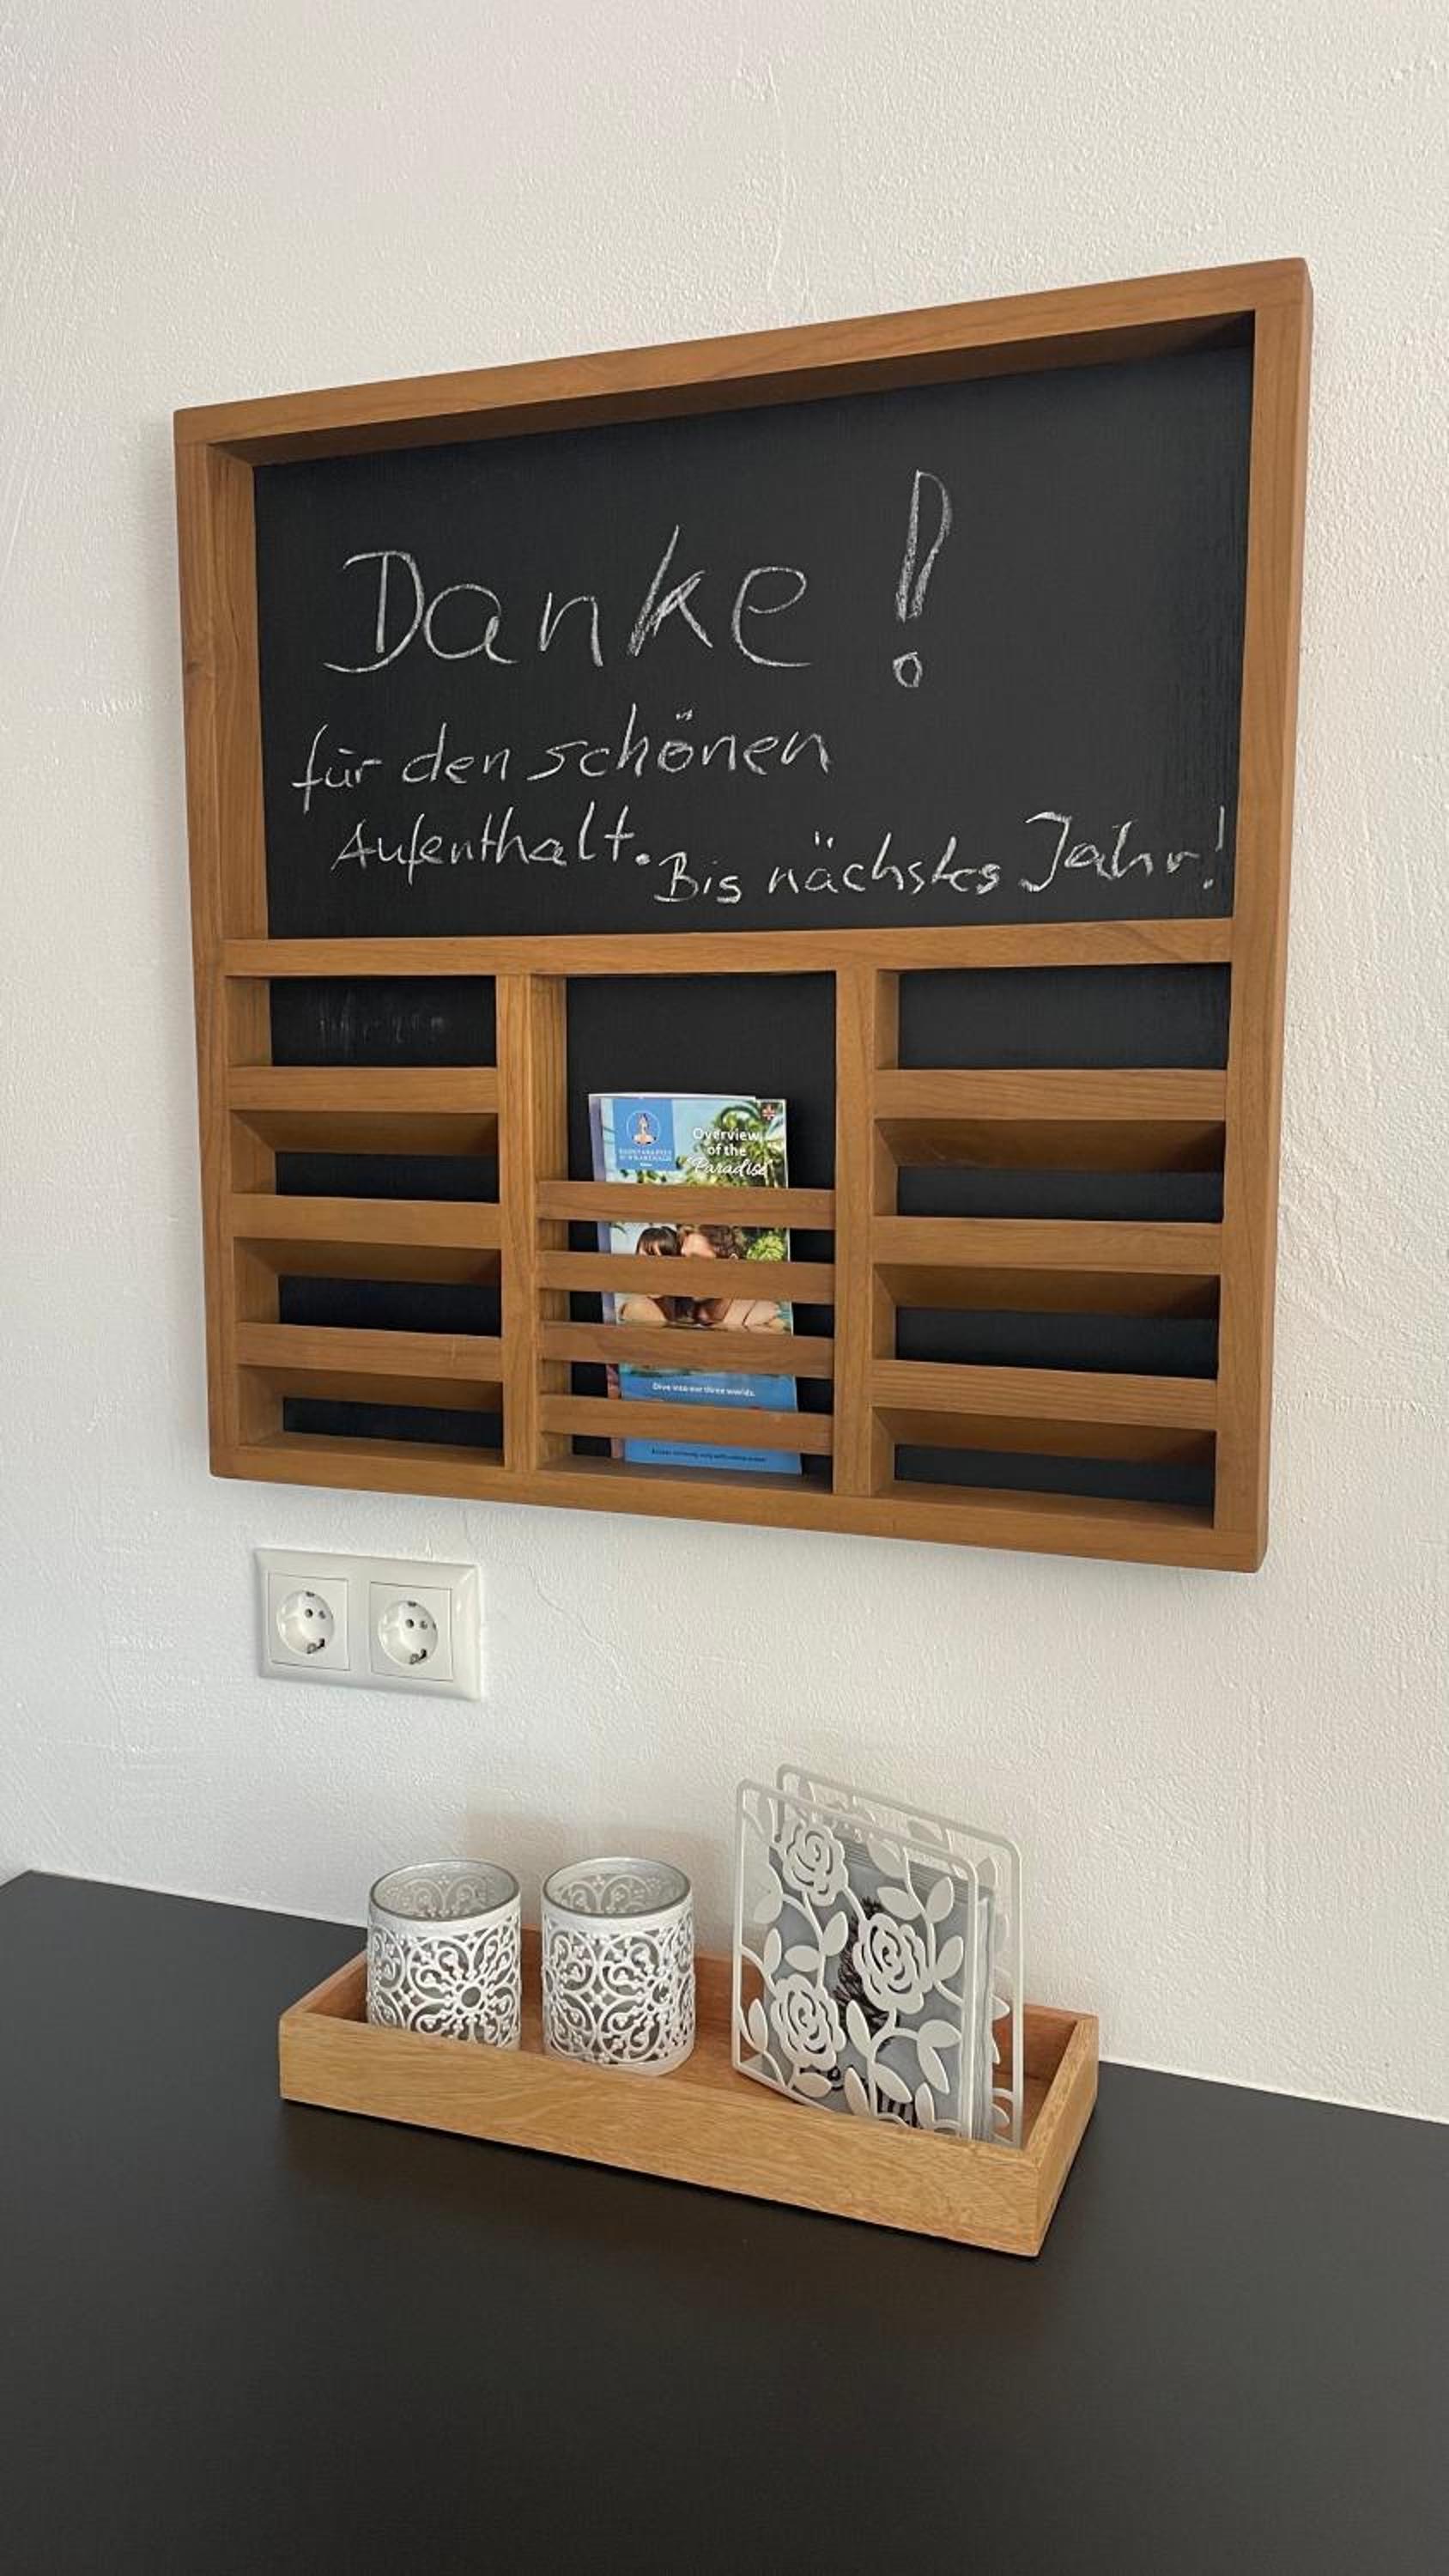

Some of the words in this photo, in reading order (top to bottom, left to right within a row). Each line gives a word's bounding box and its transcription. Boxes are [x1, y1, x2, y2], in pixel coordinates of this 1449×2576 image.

[324, 526, 809, 672] Danke
[292, 725, 381, 812] für
[403, 723, 510, 783] den
[527, 703, 829, 781] schönen
[331, 801, 650, 884] Aufenthalt.
[654, 852, 742, 903] Bis
[769, 831, 1000, 894] nächstes
[1021, 806, 1224, 892] Jahr!
[693, 1127, 761, 1142] Overview
[707, 1145, 721, 1157] of
[722, 1144, 747, 1157] the
[688, 1157, 768, 1177] Paradise
[652, 1382, 670, 1391] Dive
[672, 1383, 688, 1393] into
[704, 1384, 725, 1394] three
